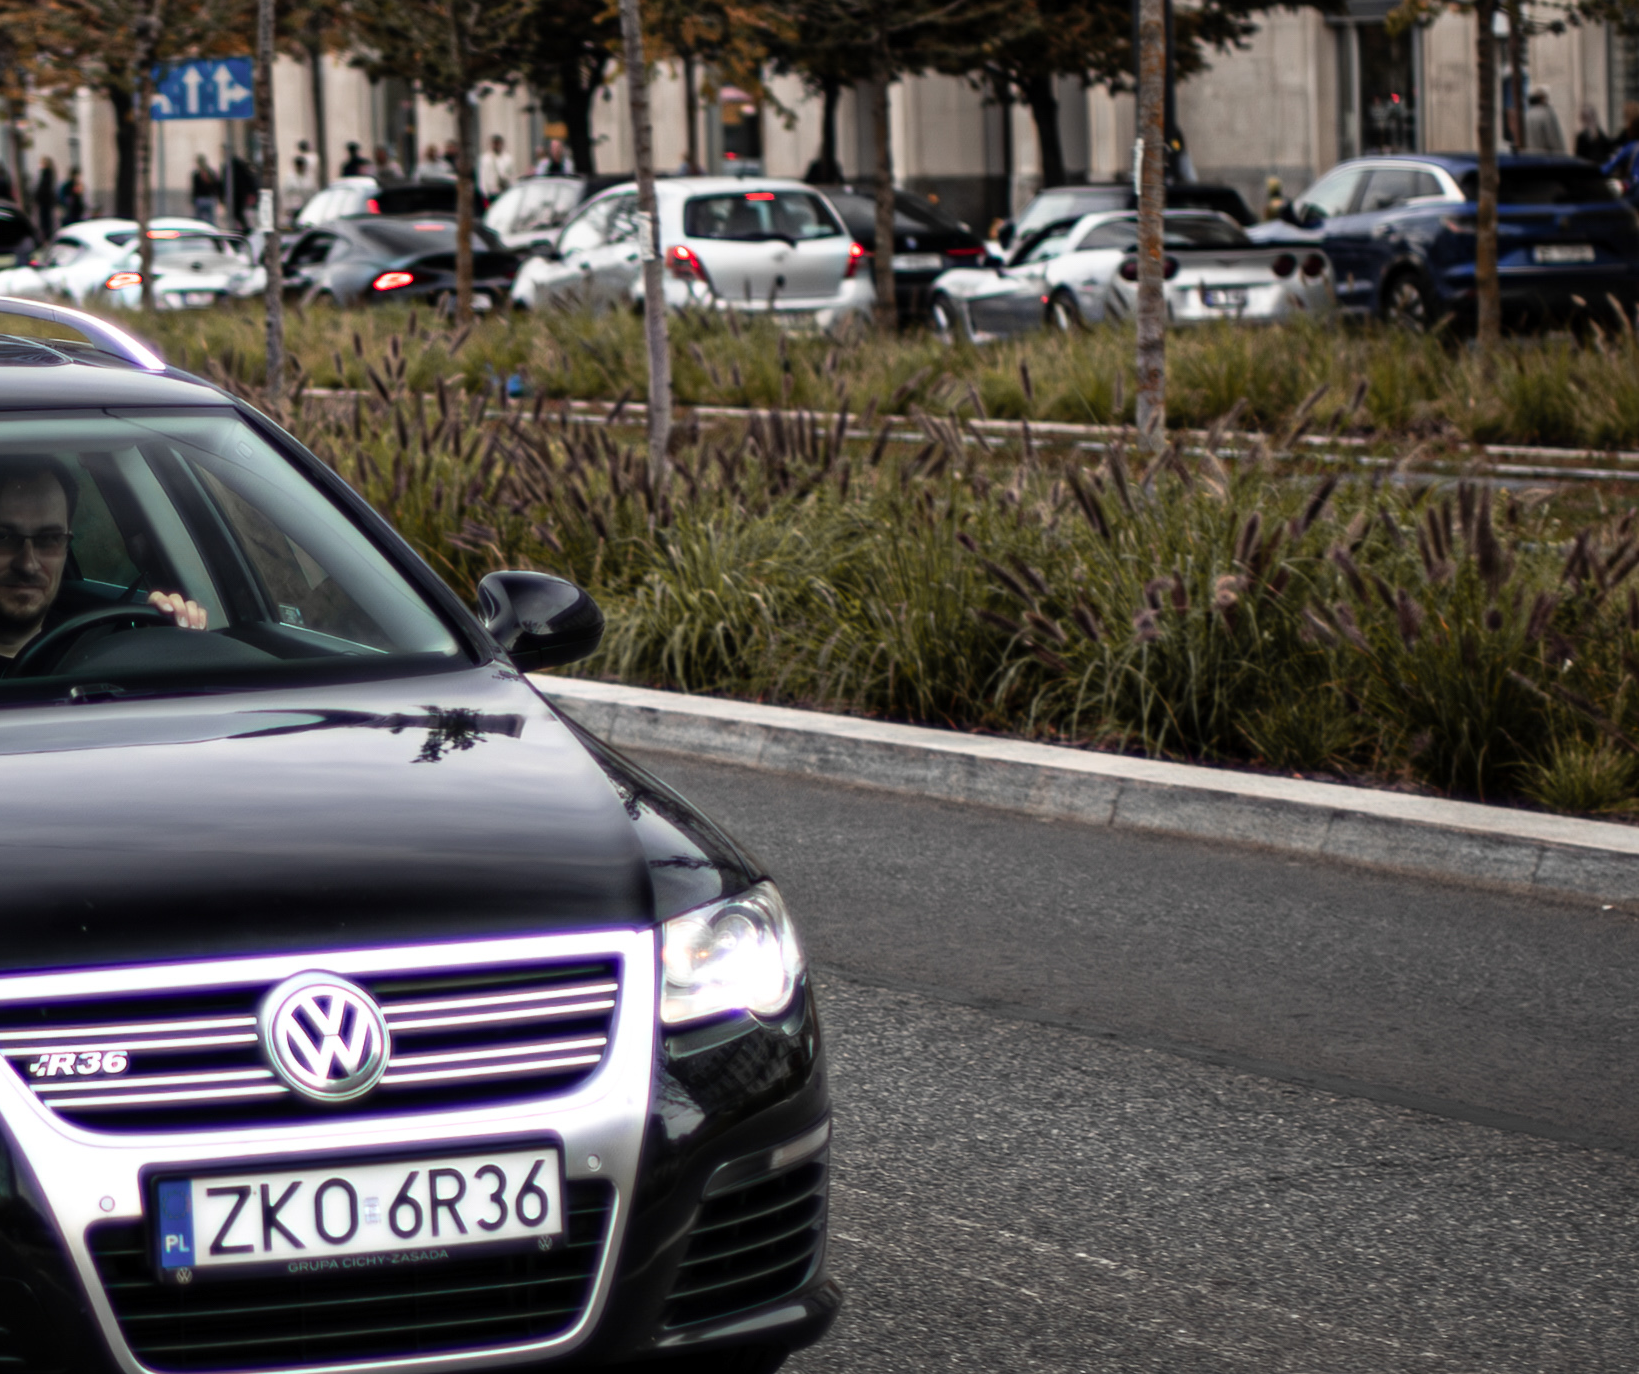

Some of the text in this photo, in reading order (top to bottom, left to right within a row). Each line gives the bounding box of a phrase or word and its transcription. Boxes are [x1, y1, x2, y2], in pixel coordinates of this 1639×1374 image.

[270, 981, 385, 1092] VW
[49, 1050, 129, 1077] R36
[206, 1159, 550, 1257] ZKO 6R36
[165, 1233, 190, 1253] PL
[288, 1249, 449, 1273] GRUPA CICHY-ZASADA
